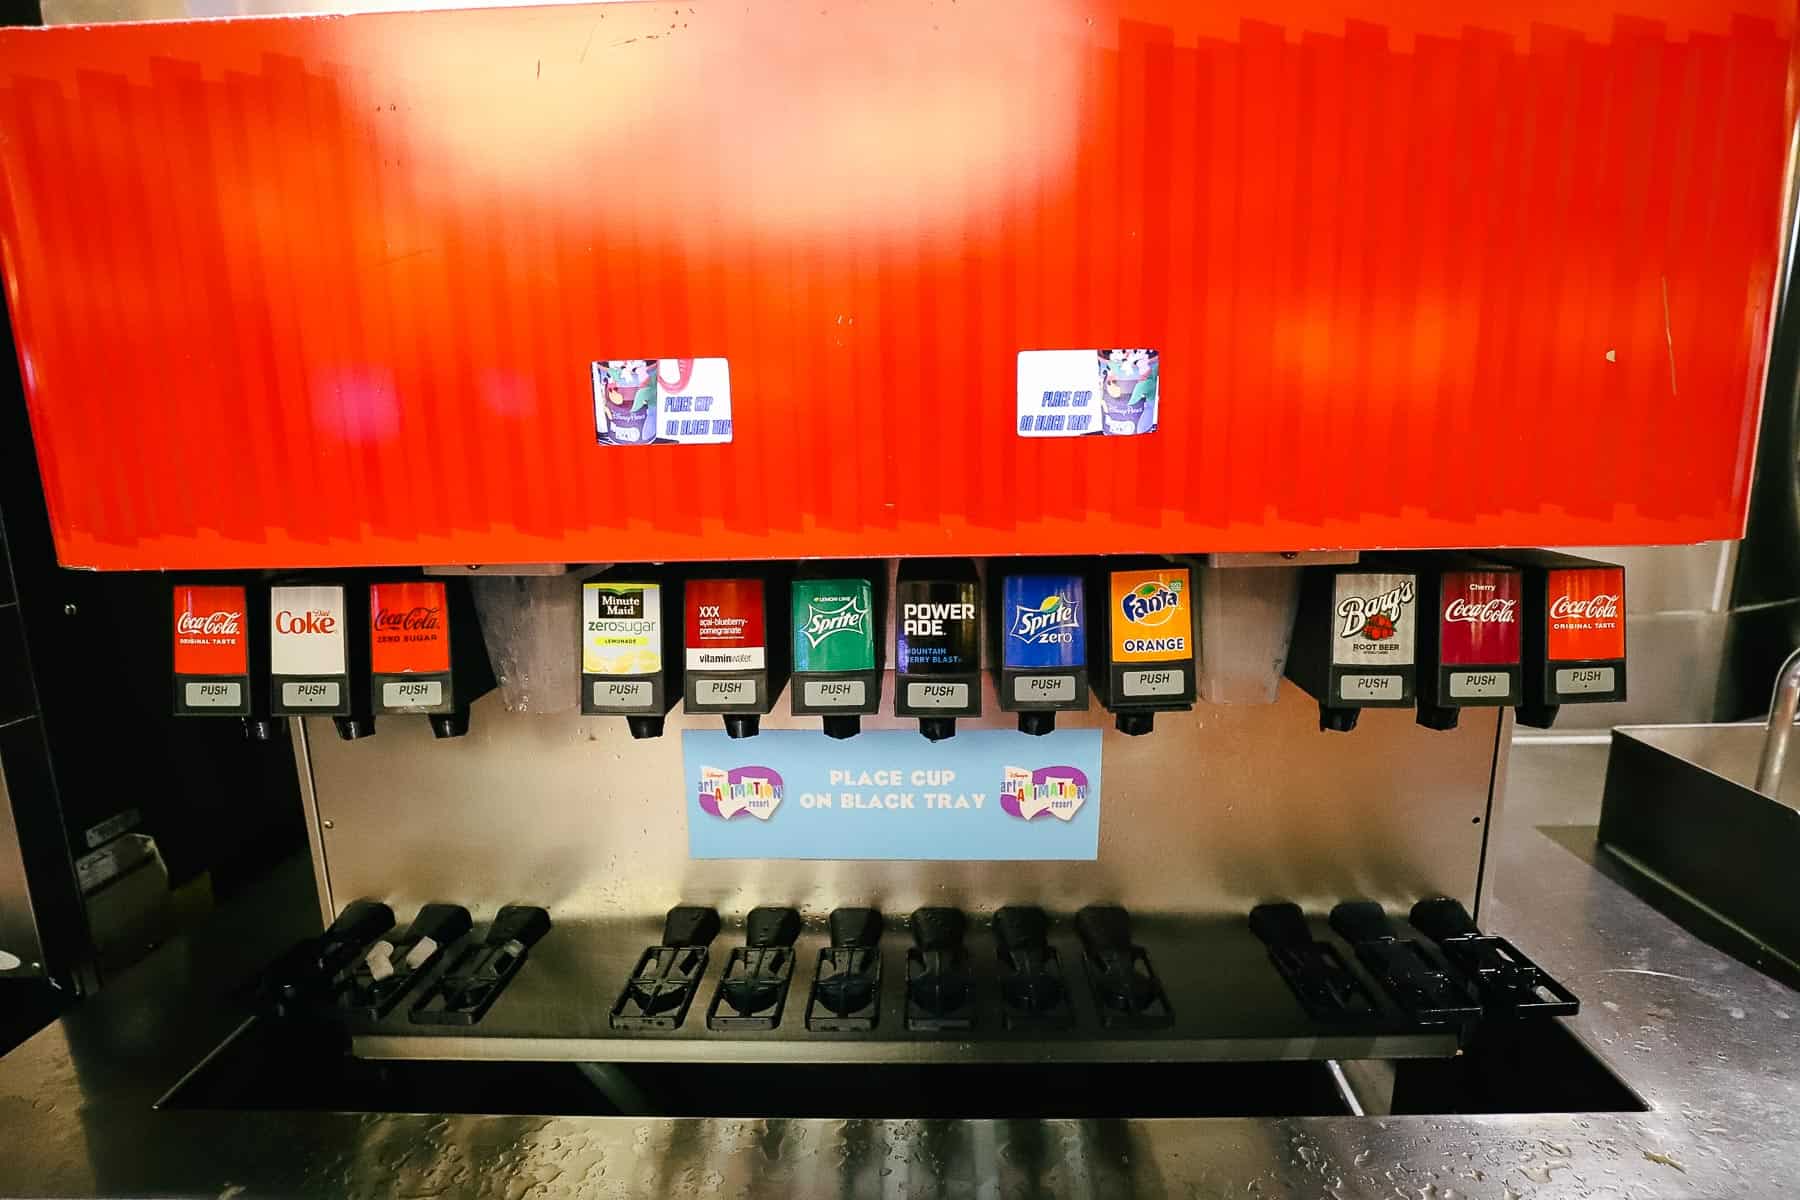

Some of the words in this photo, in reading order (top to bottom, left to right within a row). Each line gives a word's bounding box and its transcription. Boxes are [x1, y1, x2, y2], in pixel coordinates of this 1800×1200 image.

[664, 396, 692, 412] PLACE
[1041, 391, 1071, 407] PLACE
[1073, 390, 1092, 407] CUP
[1469, 583, 1496, 592] Cherry
[602, 595, 640, 606] Minute
[1122, 589, 1178, 622] Fanta
[1550, 594, 1620, 619] Coca-Cola
[607, 605, 634, 616] Maid
[904, 603, 975, 619] POWER
[1337, 581, 1415, 638] Barq's
[1445, 598, 1517, 623] Coca-Cola
[177, 611, 241, 635] Coca-Cola
[275, 611, 336, 634] Coke
[374, 607, 441, 631] Coca-Cola
[808, 610, 860, 634] Sprite
[1018, 604, 1073, 635] Sprite
[588, 621, 656, 635] zerosugar
[377, 635, 400, 643] ZERO
[404, 634, 437, 642] SUGAR
[1038, 632, 1073, 643] zero
[1124, 638, 1184, 652] ORANGE
[699, 653, 751, 663] vitaminwater
[1140, 673, 1170, 684] PUSH
[1465, 675, 1496, 685] PUSH
[1571, 671, 1601, 682] PUSH
[200, 685, 228, 695] PUSH
[298, 685, 326, 695] PUSH
[399, 685, 428, 695] PUSH
[609, 684, 639, 695] PUSH
[711, 683, 742, 693] PUSH
[820, 684, 851, 694] PUSH
[1031, 680, 1061, 689] PUSH
[1358, 679, 1389, 689] PUSH
[923, 686, 954, 696] PUSH
[829, 769, 903, 787] PLACE
[911, 769, 956, 787] CUP
[715, 782, 782, 801] ANIMATION
[1000, 779, 1016, 793] art
[1017, 782, 1084, 802] ANIMATION
[800, 793, 832, 809] ON
[840, 793, 914, 809] BLACK
[924, 793, 986, 809] TRAY
[1051, 800, 1072, 808] resort
